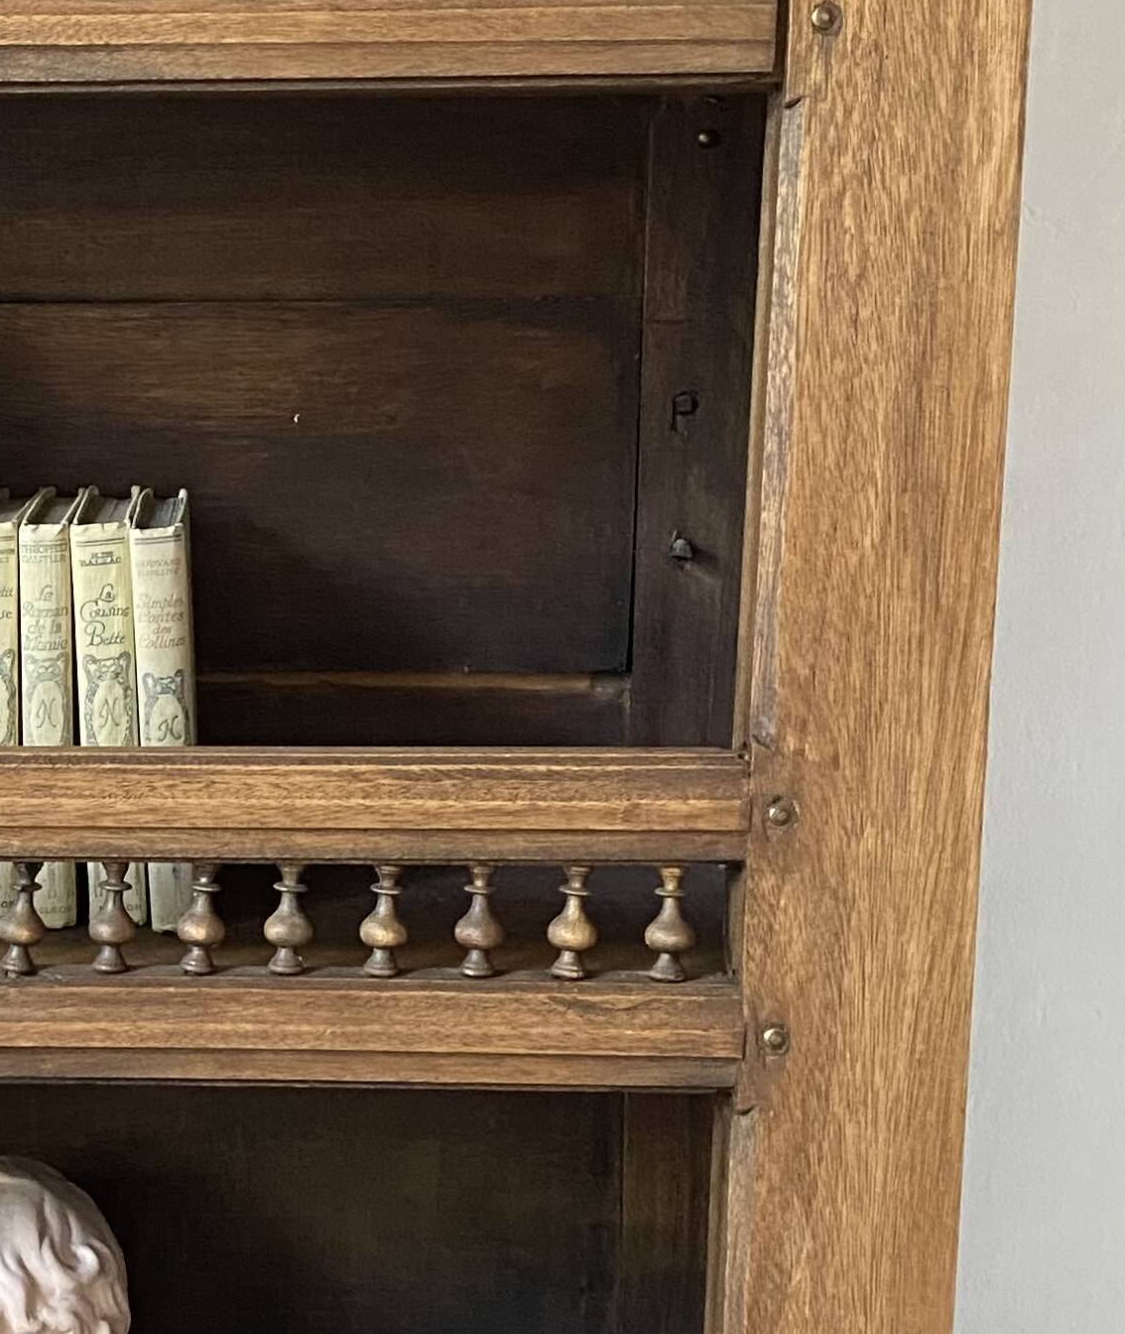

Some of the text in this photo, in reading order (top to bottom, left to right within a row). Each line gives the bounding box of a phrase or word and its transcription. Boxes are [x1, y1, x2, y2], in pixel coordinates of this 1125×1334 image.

[35, 584, 54, 602] Le
[96, 583, 116, 603] La
[22, 601, 69, 619] Roman
[79, 599, 131, 623] Cousine
[27, 618, 46, 635] de
[83, 620, 126, 648] Bette
[35, 698, 57, 729] N
[99, 697, 121, 730] N
